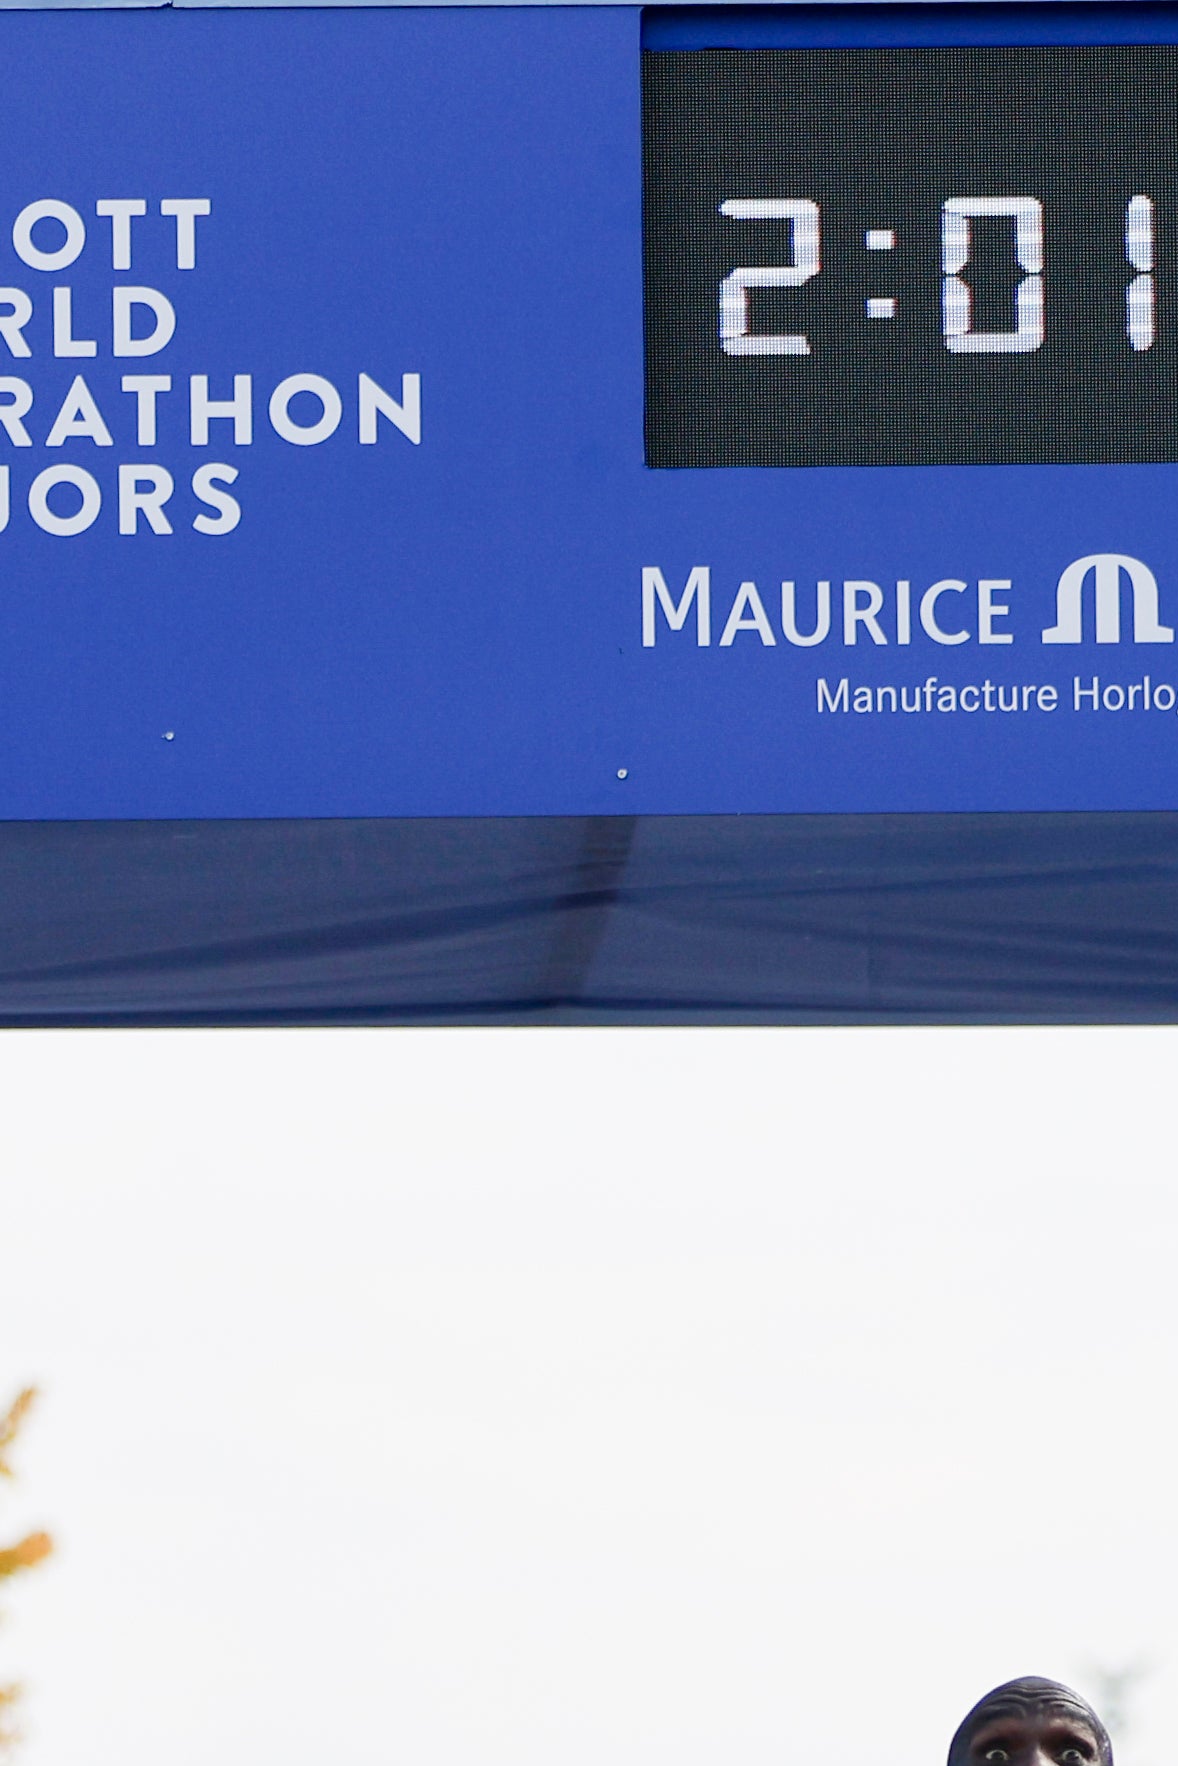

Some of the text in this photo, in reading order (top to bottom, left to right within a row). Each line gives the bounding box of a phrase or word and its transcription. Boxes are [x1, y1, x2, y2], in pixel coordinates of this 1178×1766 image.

[12, 199, 212, 272] OTT
[0, 287, 177, 358] RLD
[0, 373, 422, 447] RATHON
[816, 678, 1058, 714] Manufacture
